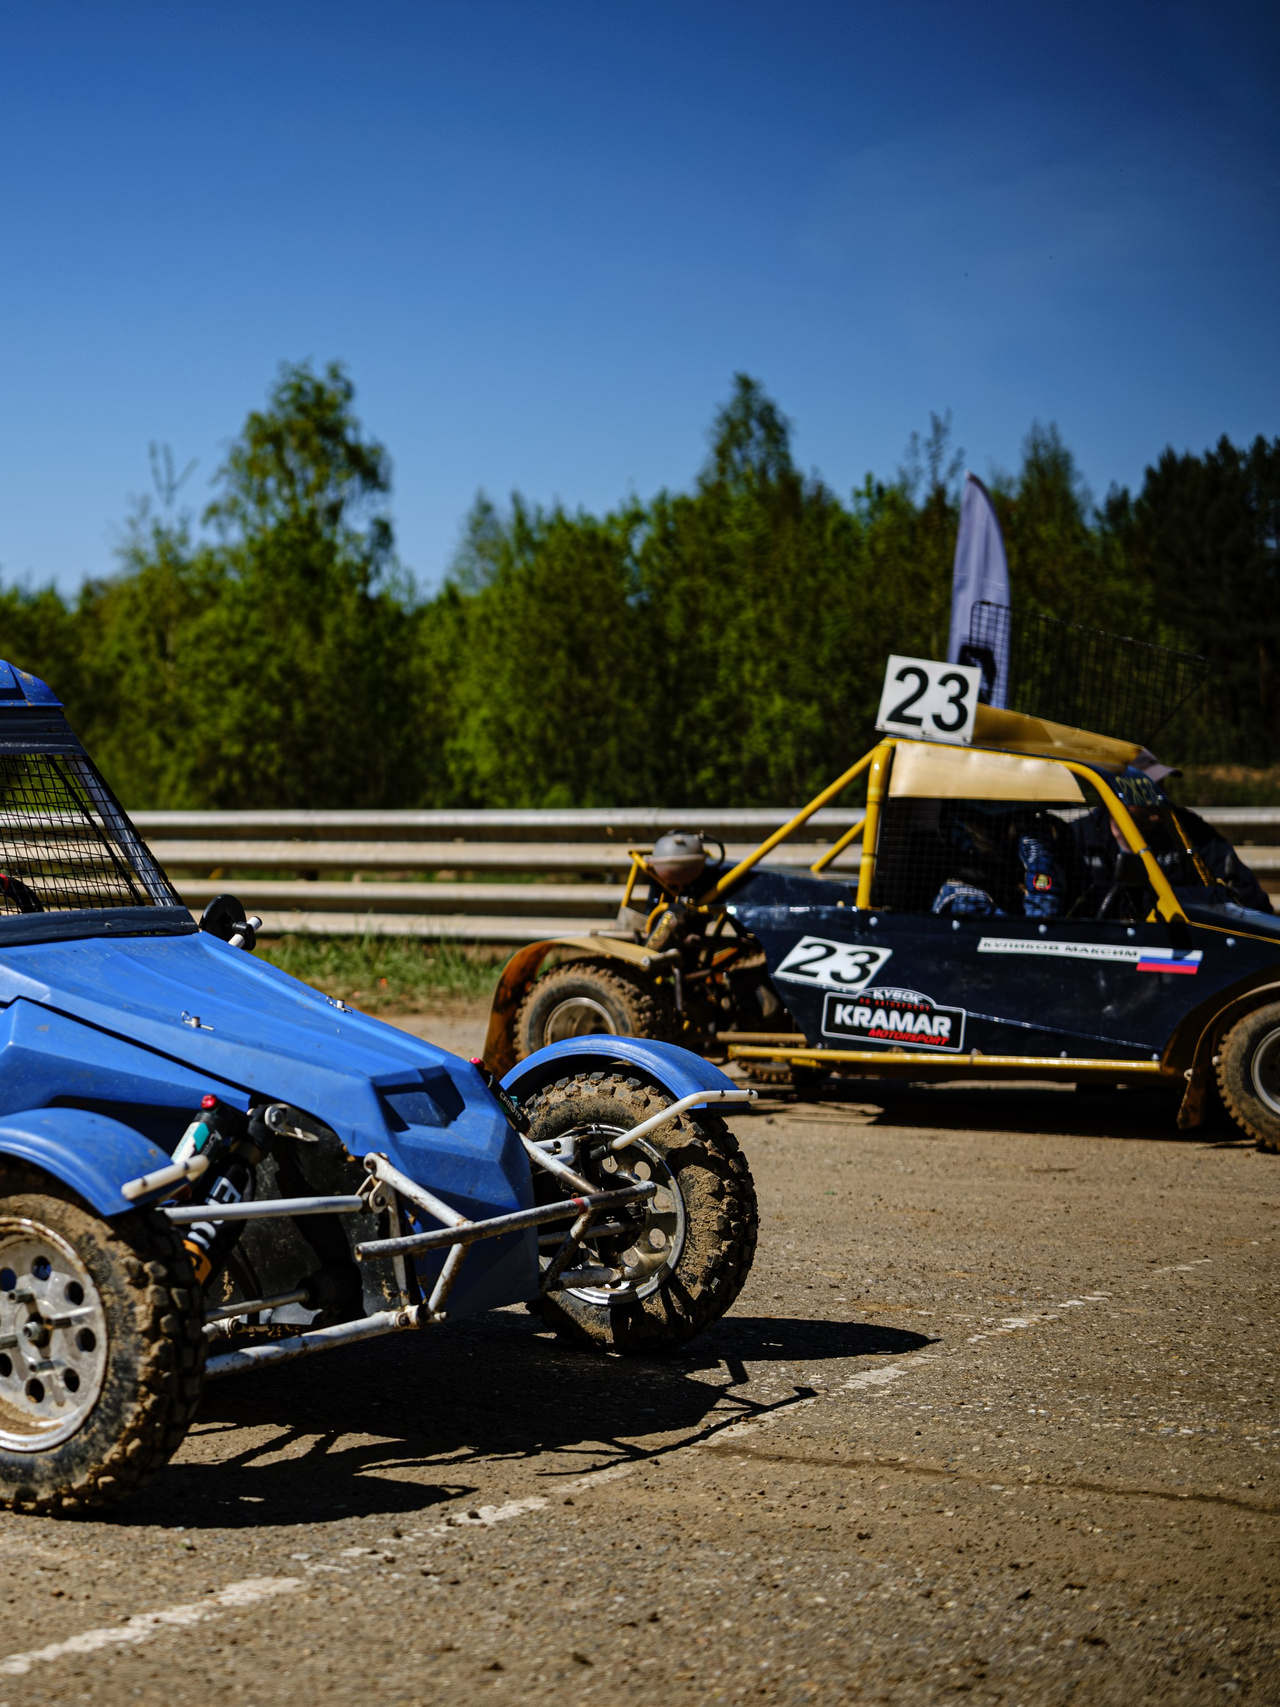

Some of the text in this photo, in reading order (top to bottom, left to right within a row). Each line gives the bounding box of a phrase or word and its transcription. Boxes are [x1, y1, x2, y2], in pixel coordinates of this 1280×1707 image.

[886, 667, 969, 732] 23
[781, 943, 880, 984] 23
[1065, 944, 1139, 958] МАКСИМ
[834, 1003, 952, 1037] KRAMAR
[868, 1028, 950, 1046] MOTORSPORT
